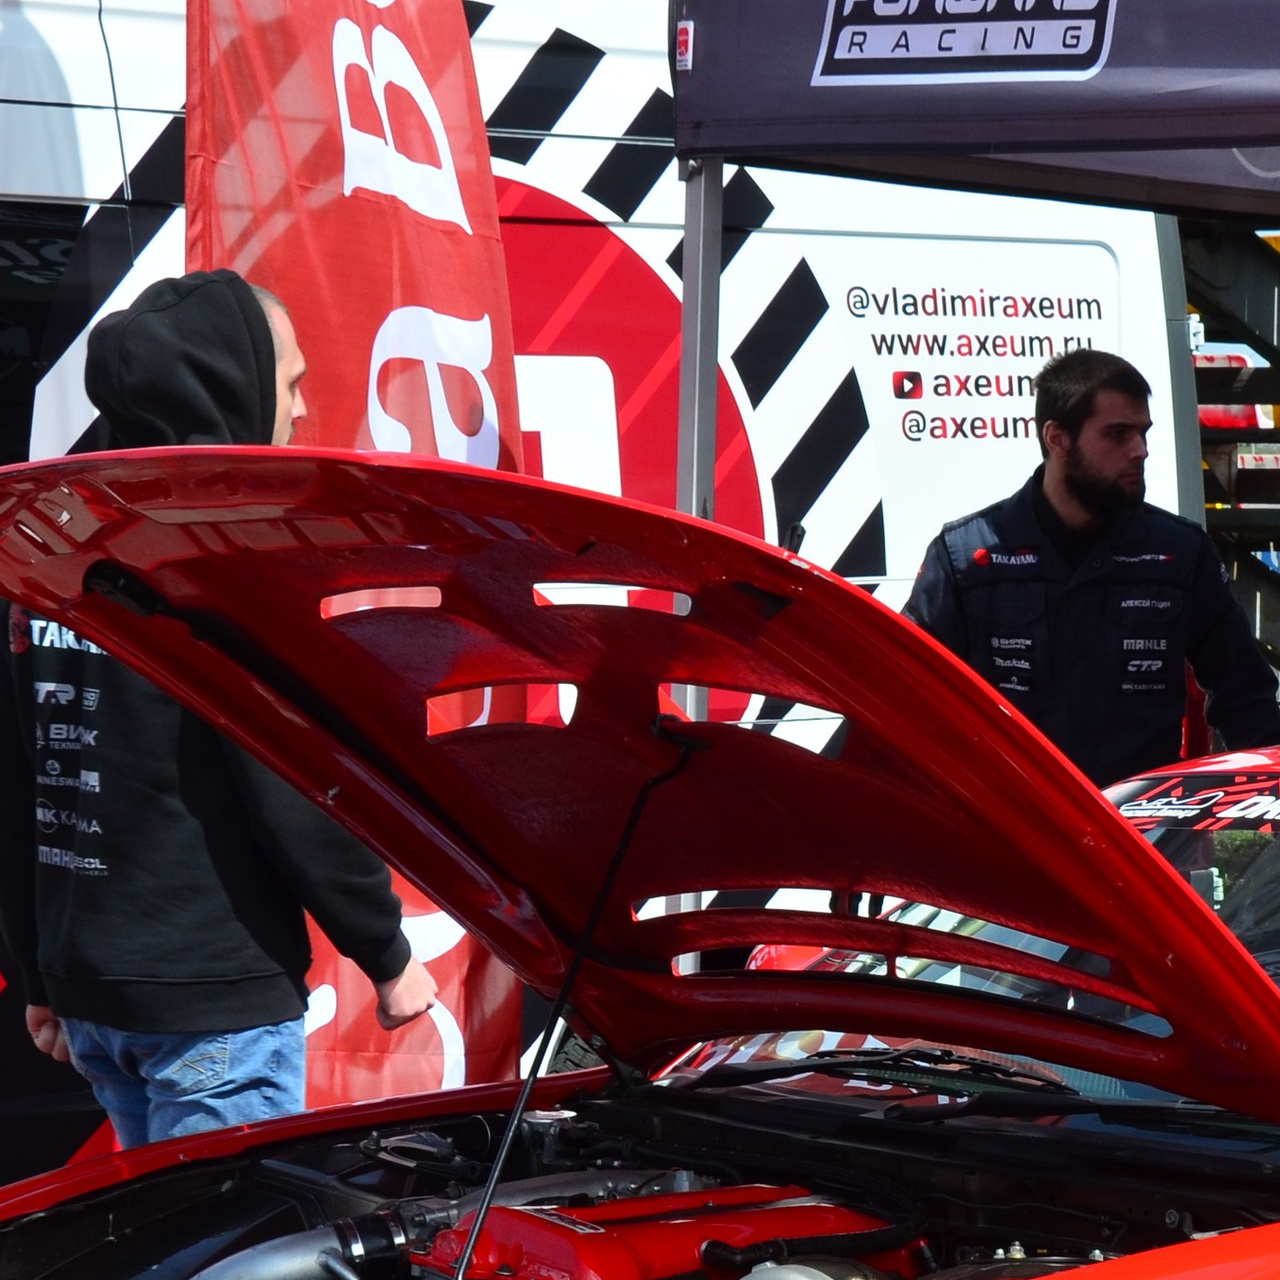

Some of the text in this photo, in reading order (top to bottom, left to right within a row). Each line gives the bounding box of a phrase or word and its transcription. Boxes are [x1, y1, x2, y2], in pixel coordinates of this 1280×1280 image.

[848, 26, 1082, 53] RACING
[846, 286, 1102, 319] @vladimiraxeum
[1123, 639, 1167, 650] MAHLE
[1127, 660, 1163, 672] CTR
[34, 682, 76, 705] TR
